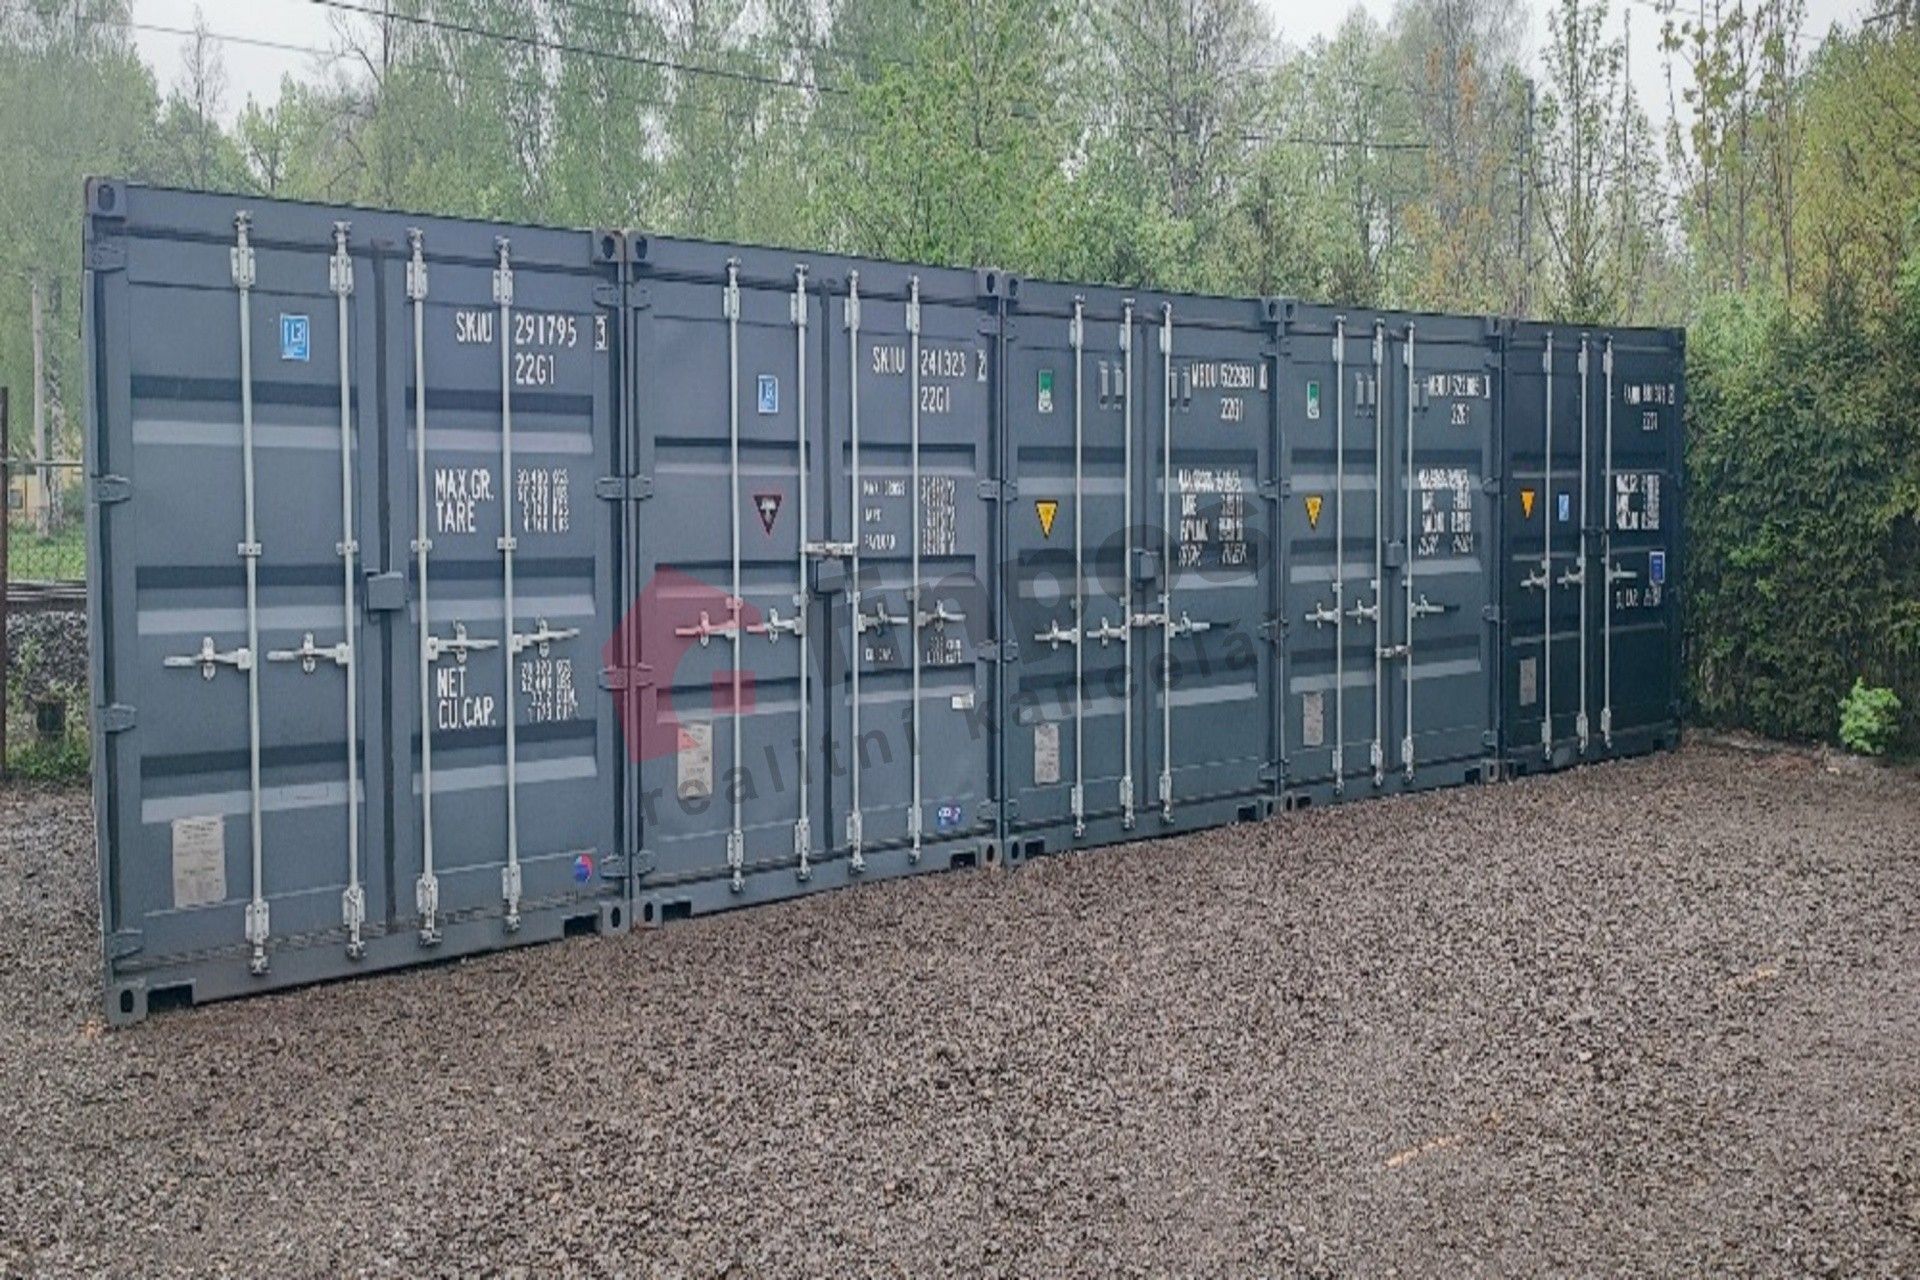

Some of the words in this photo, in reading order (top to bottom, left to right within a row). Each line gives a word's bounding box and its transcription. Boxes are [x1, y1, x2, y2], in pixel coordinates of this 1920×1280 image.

[456, 311, 493, 343] SKIU
[515, 314, 577, 348] 291795
[515, 352, 555, 385] 22G1
[872, 346, 906, 374] SKIU
[920, 348, 967, 378] 241323
[920, 386, 951, 414] 22G1
[436, 499, 477, 533] TARE
[436, 666, 467, 698] NET
